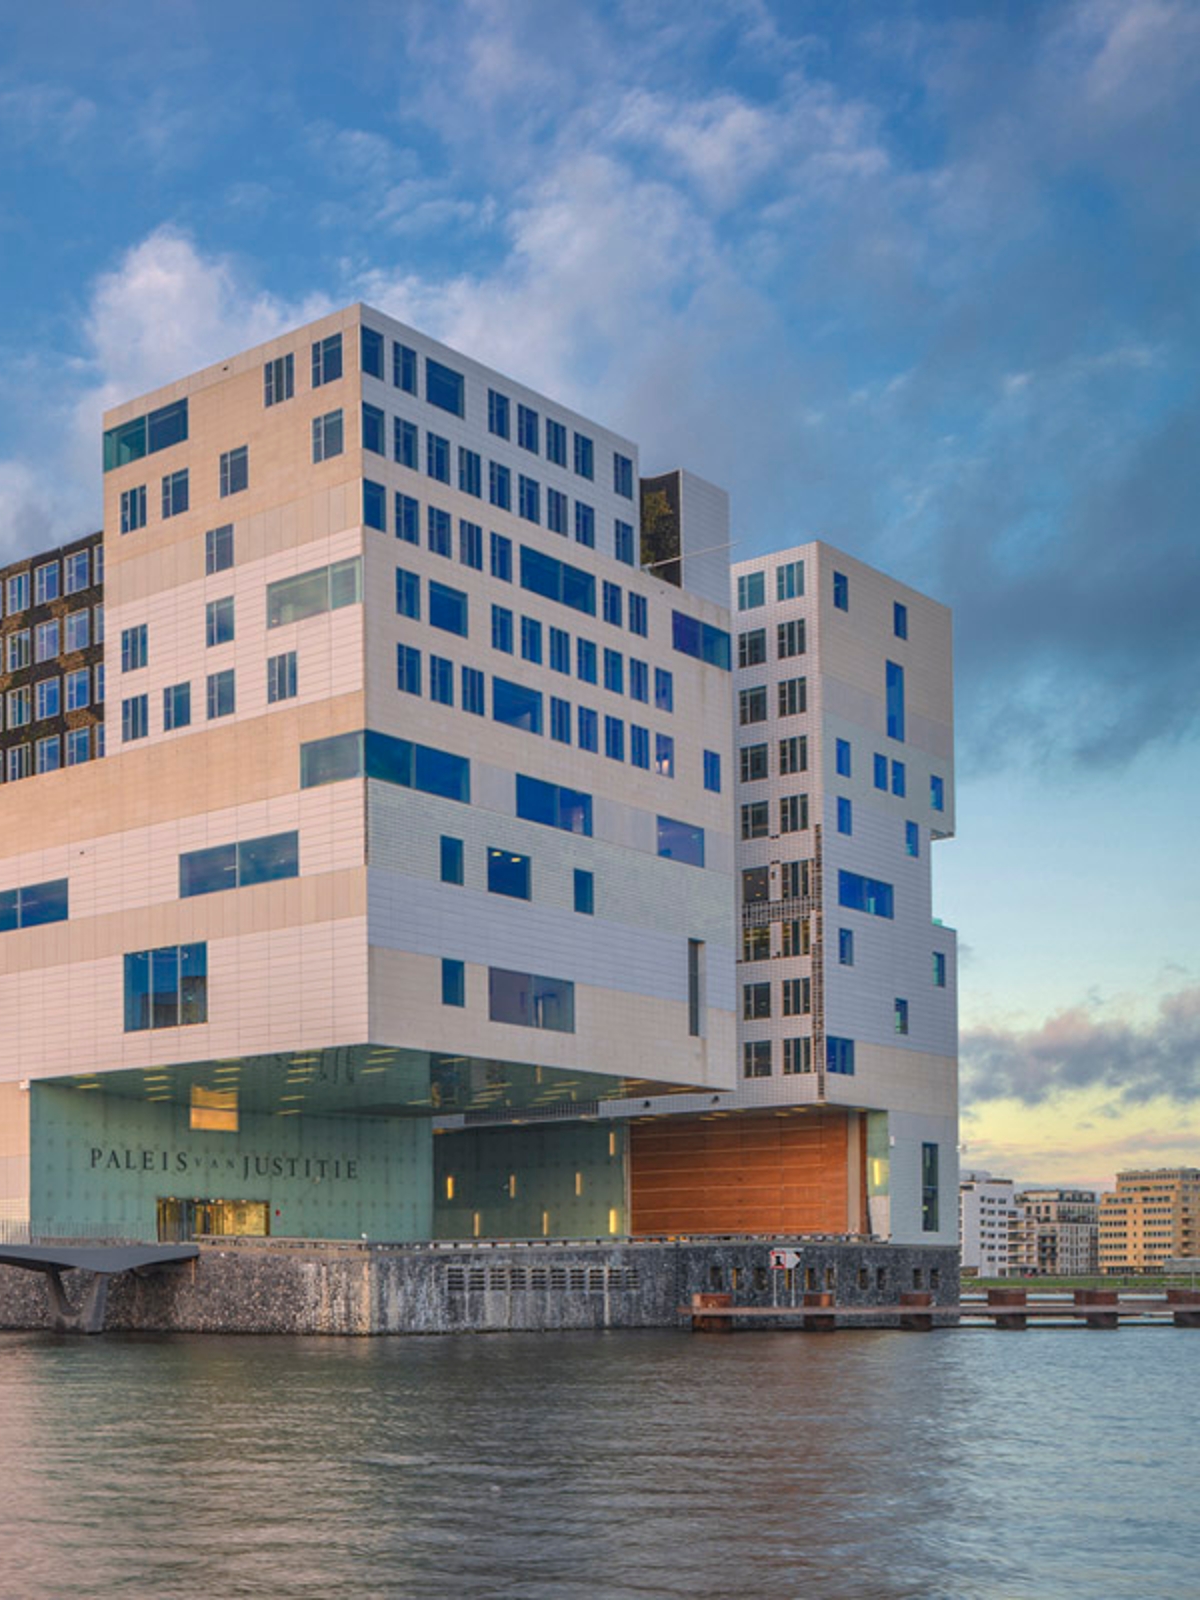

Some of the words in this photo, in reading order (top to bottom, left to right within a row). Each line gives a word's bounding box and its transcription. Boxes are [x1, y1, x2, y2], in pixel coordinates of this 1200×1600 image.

[90, 1147, 188, 1171] PALEIS
[194, 1157, 235, 1169] VAN
[243, 1155, 358, 1180] JUSTITIE
